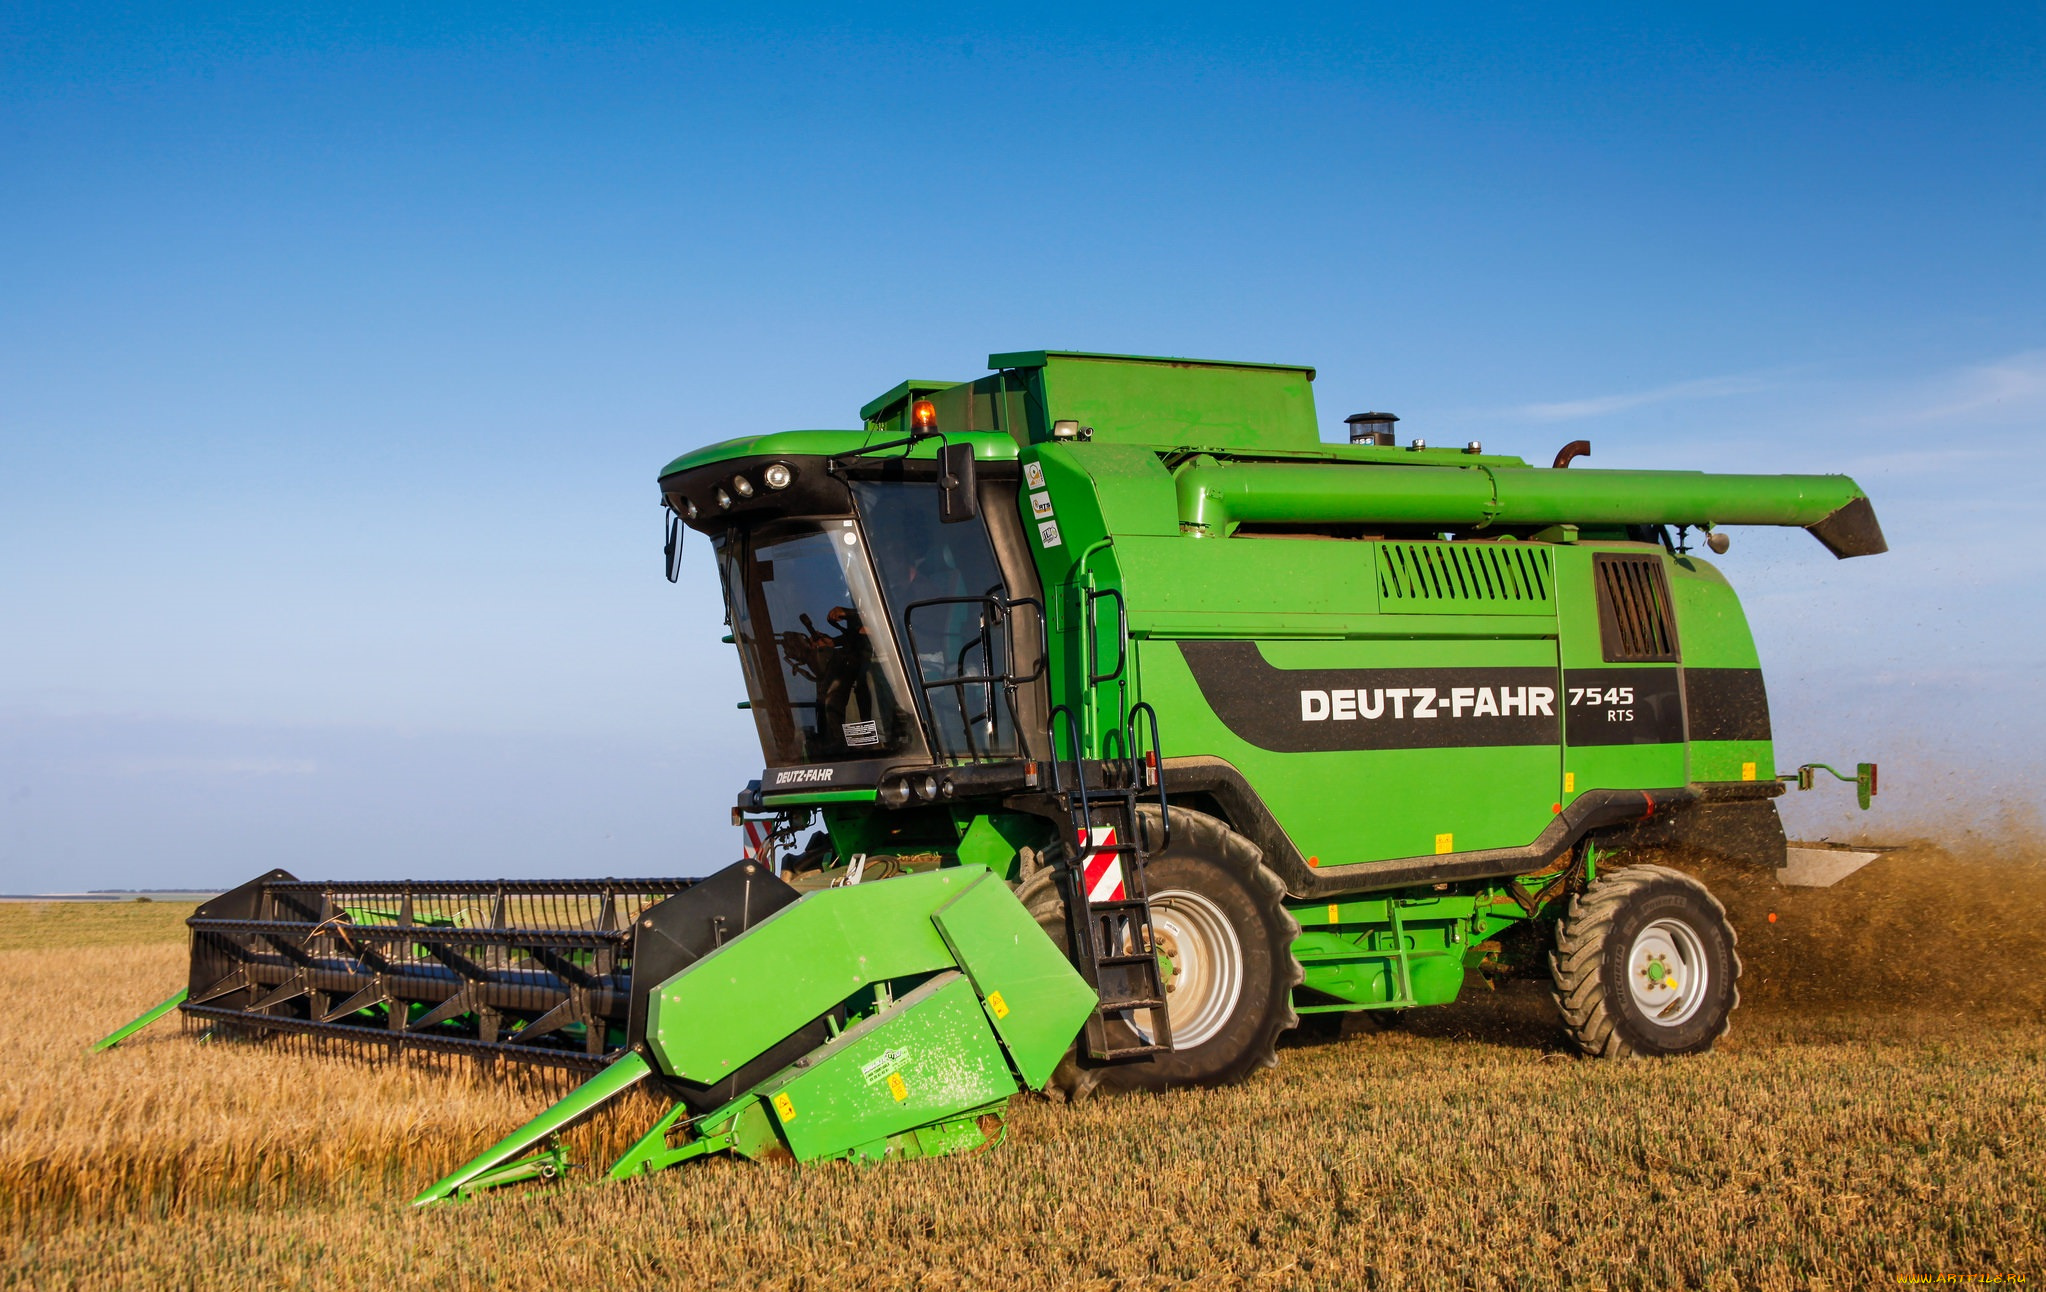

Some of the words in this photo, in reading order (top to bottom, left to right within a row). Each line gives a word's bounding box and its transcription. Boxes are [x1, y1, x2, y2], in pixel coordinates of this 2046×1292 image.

[1301, 686, 1555, 721] DEUTZ-FAHR
[1568, 687, 1634, 706] 7545
[1607, 709, 1634, 722] RTS
[775, 768, 834, 785] DEUTZ-FAHR
[1615, 945, 1627, 1005] MICHELIN
